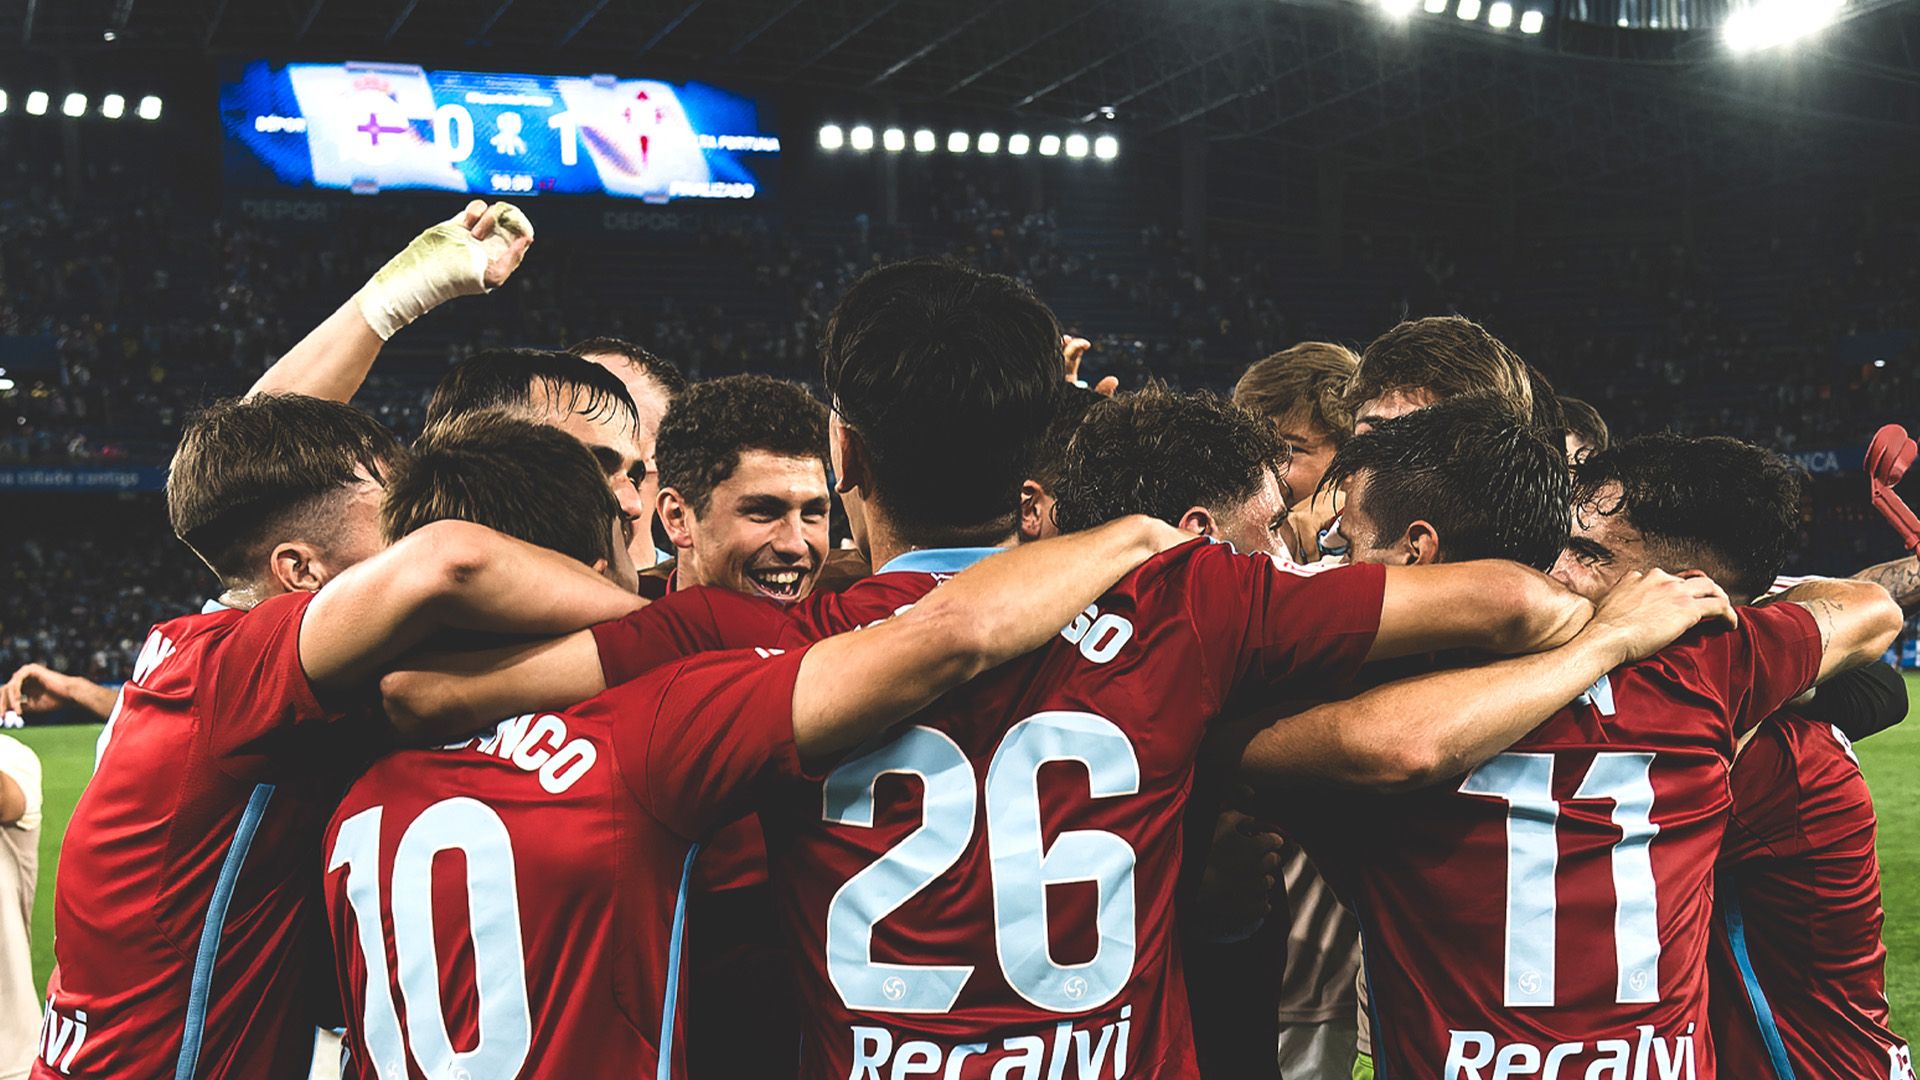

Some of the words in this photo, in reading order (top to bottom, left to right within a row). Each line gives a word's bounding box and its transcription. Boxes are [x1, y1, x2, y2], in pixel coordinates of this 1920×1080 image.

[435, 103, 474, 163] 0
[548, 110, 578, 166] 1
[327, 796, 533, 1080] 10
[822, 711, 1139, 1014] 26
[1457, 751, 1661, 1007] 11
